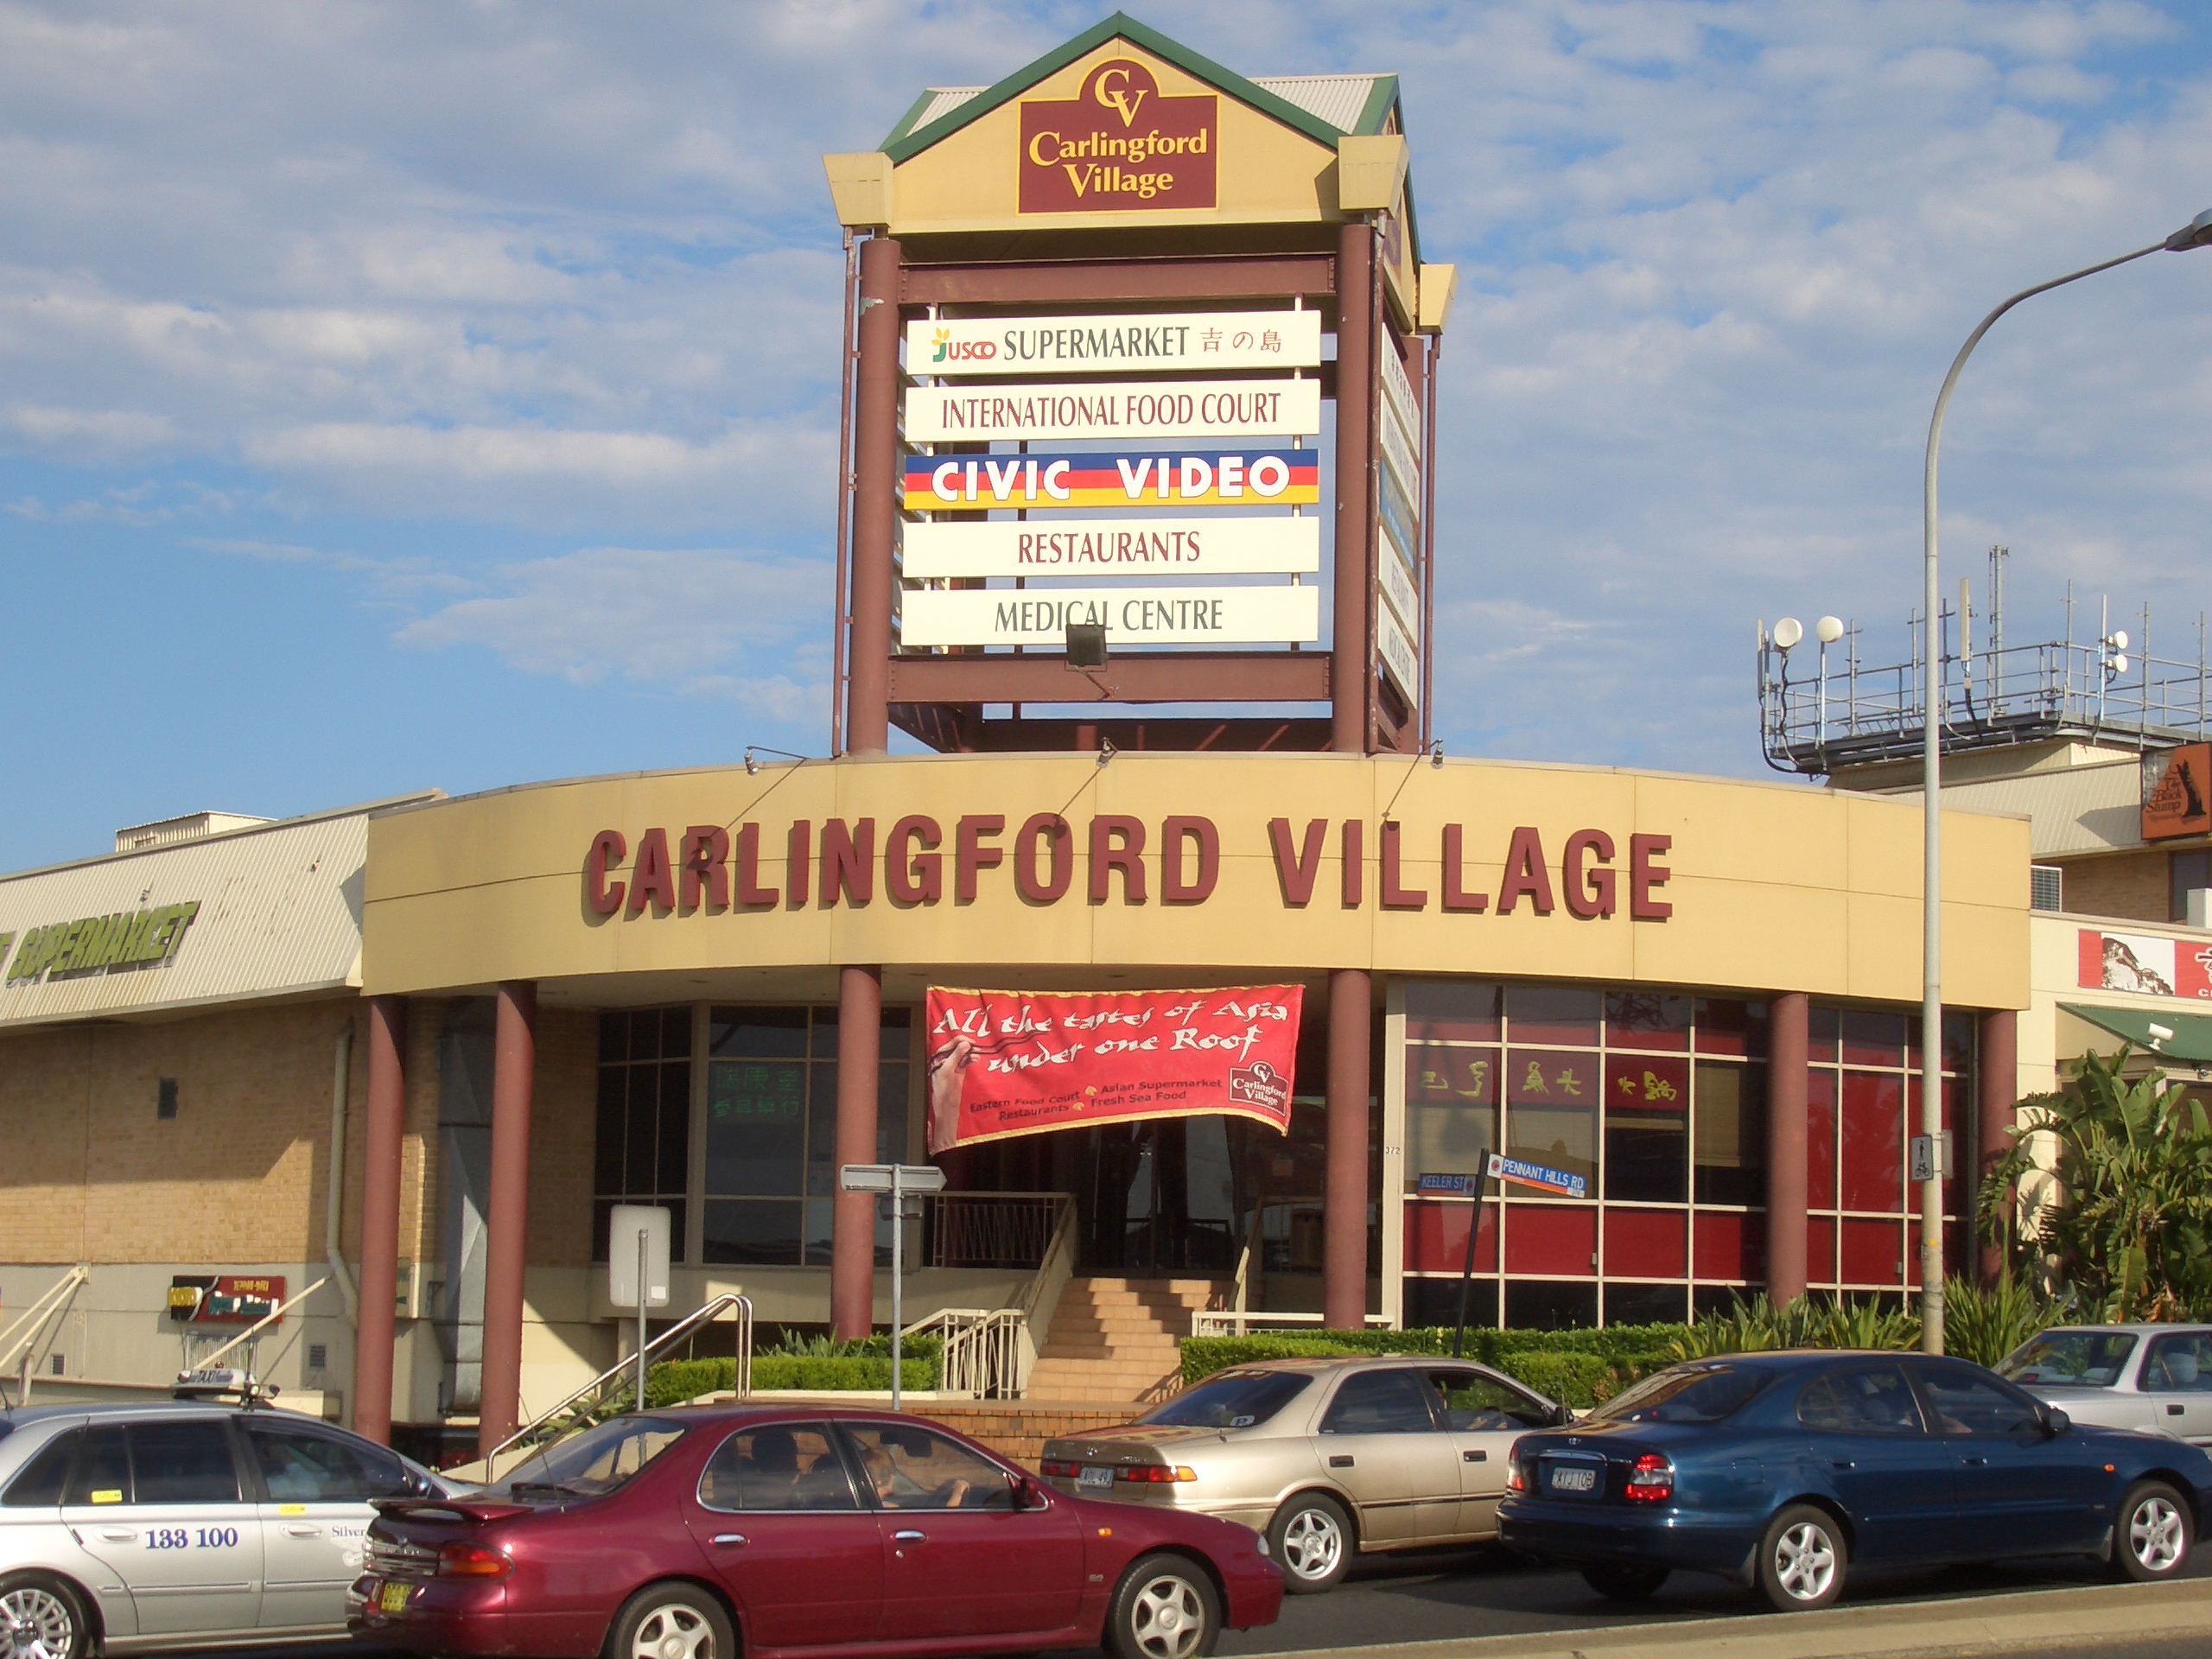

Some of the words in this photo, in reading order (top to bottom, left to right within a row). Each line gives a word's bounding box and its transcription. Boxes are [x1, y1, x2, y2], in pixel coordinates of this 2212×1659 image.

[1028, 128, 1207, 167] Carlingford
[1062, 162, 1173, 199] Village
[1004, 326, 1190, 360] SUPERMARKET
[942, 394, 1119, 429] INTERNATIONAL
[1126, 392, 1193, 426] FOOD
[1201, 391, 1281, 424] COURT
[931, 460, 1071, 502] CIVIC
[1116, 455, 1291, 499] VIDEO
[1018, 531, 1200, 564] RESTAURANTS
[995, 600, 1112, 632] MEDICAL
[1122, 599, 1224, 631] CENTRE
[588, 815, 1219, 918] CARLINGFORD
[1269, 817, 1673, 918] VILLAGE
[7, 899, 202, 982] SUPERMARKET
[933, 1003, 992, 1037] All
[1000, 1004, 1052, 1034] the
[1063, 1007, 1154, 1030] tastes
[1164, 999, 1207, 1025] of
[1211, 1000, 1288, 1022] Asia
[987, 1040, 1085, 1074] under
[1095, 1029, 1160, 1055] one
[1170, 1023, 1264, 1063] Roof
[969, 1099, 1011, 1113] Eastern
[1048, 1090, 1080, 1103] Court
[1100, 1083, 1135, 1094] Asian
[1138, 1079, 1223, 1091] Supermarket
[1232, 1077, 1287, 1100] Carlingford
[1244, 1088, 1279, 1106] Village
[998, 1104, 1070, 1121] Restaurants
[1090, 1096, 1125, 1108] Fresh
[1128, 1093, 1152, 1103] Sea
[1155, 1090, 1186, 1101] Food
[1385, 1146, 1401, 1155] 372
[1421, 1175, 1452, 1189] KEELER
[1453, 1175, 1465, 1190] ST
[1503, 1158, 1543, 1180] PENNANT
[1545, 1167, 1569, 1187] HILLS
[1571, 1174, 1584, 1190] RD
[145, 1529, 188, 1549] 133
[195, 1527, 238, 1548] 100
[332, 1525, 366, 1537] Silver
